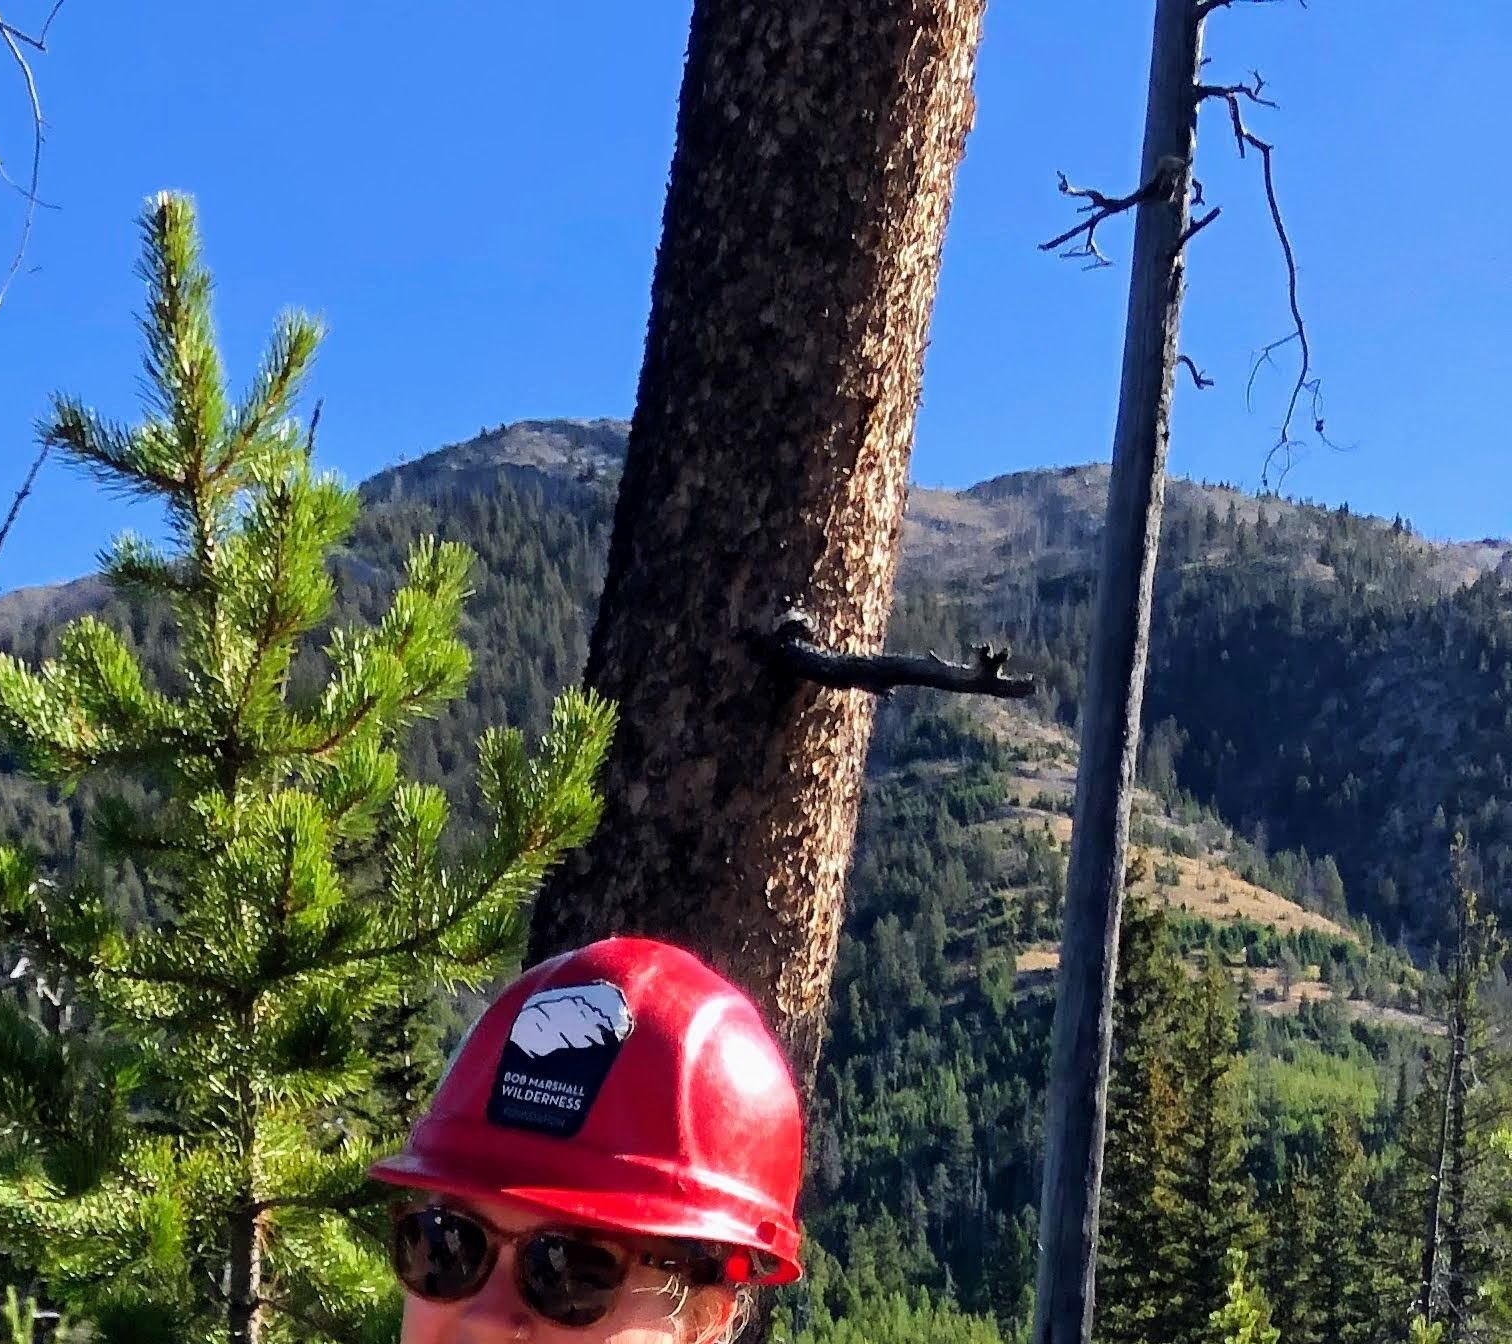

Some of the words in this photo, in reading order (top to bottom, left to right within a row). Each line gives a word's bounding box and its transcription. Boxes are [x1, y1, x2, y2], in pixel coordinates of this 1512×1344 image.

[502, 1084, 582, 1110] WILDERNESS
[504, 1071, 527, 1085] BOB
[528, 1077, 584, 1097] MARSHALL
